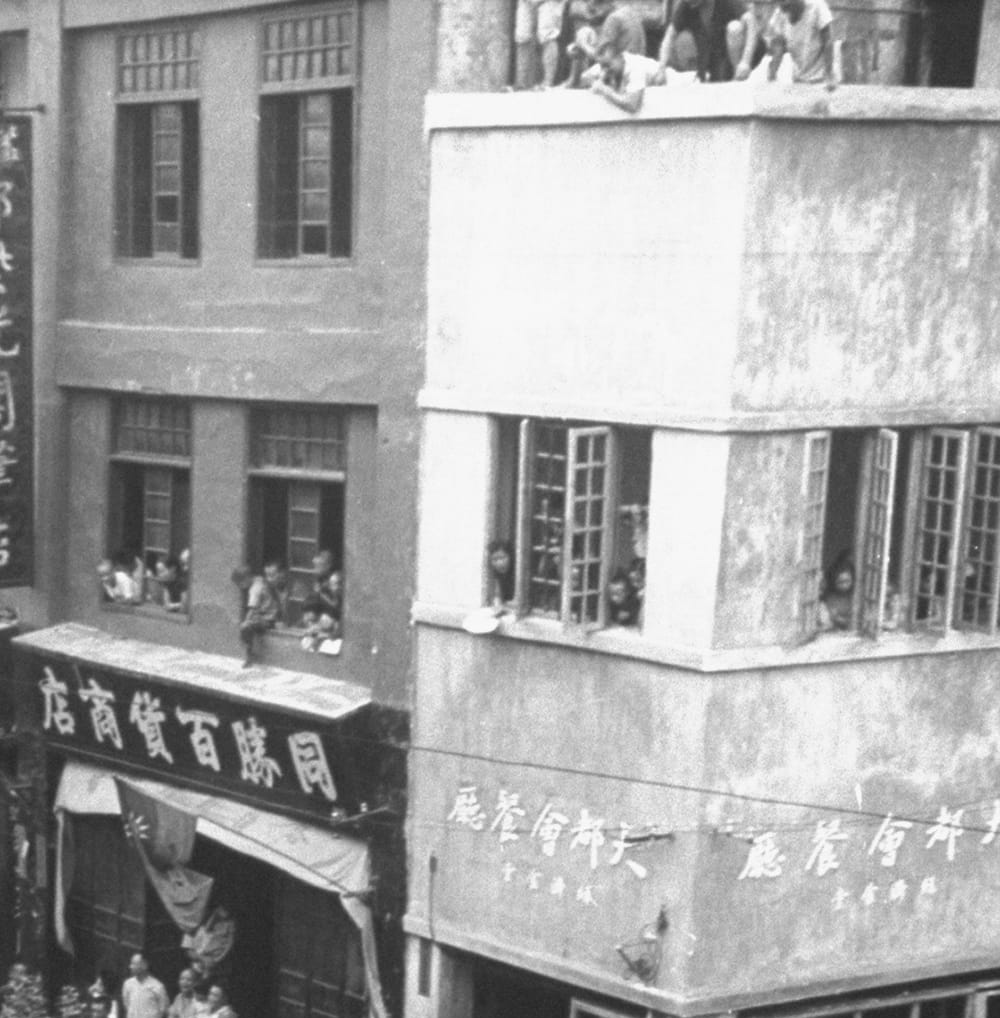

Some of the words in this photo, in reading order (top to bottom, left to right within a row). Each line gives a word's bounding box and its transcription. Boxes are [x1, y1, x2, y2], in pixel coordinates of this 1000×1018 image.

[38, 666, 338, 802] 同勝百貨商店
